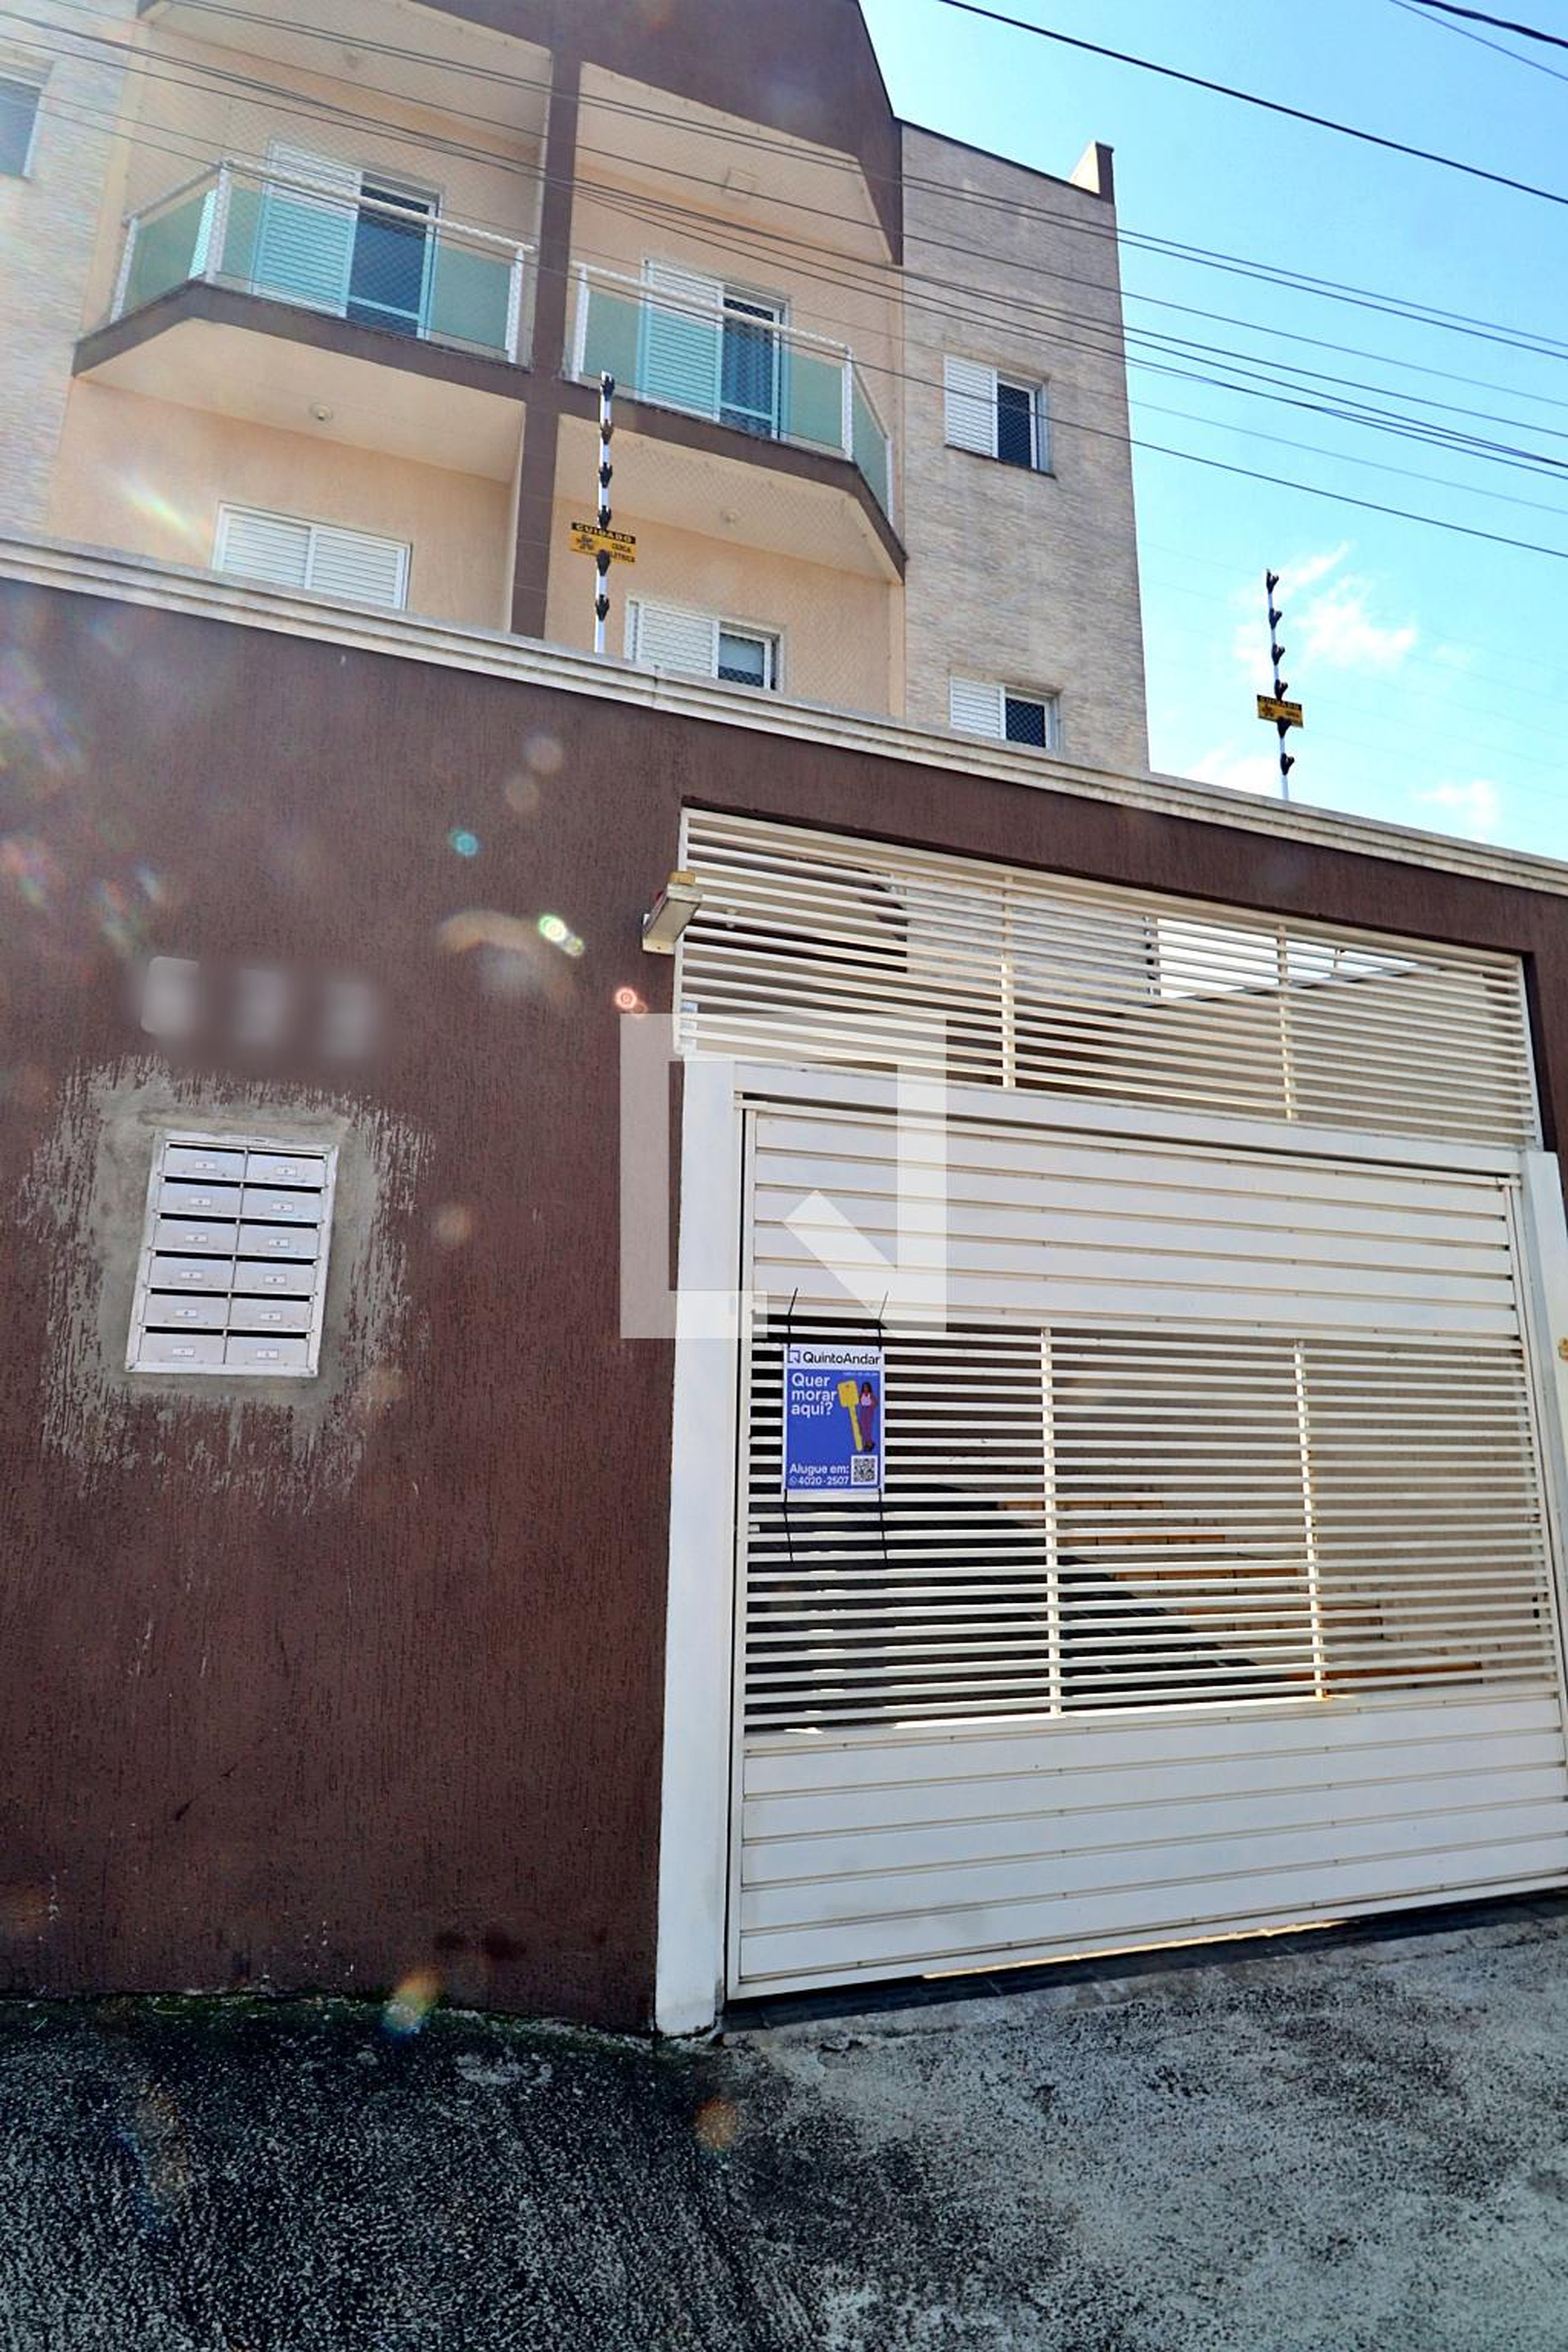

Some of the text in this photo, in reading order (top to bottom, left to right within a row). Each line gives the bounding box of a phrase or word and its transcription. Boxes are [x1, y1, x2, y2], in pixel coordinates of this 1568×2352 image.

[803, 1351, 880, 1365] QuintoAndar
[792, 1373, 830, 1388] Quer
[792, 1390, 837, 1401] morar
[791, 1402, 833, 1418] aqui?
[789, 1463, 849, 1476] Alugue em:
